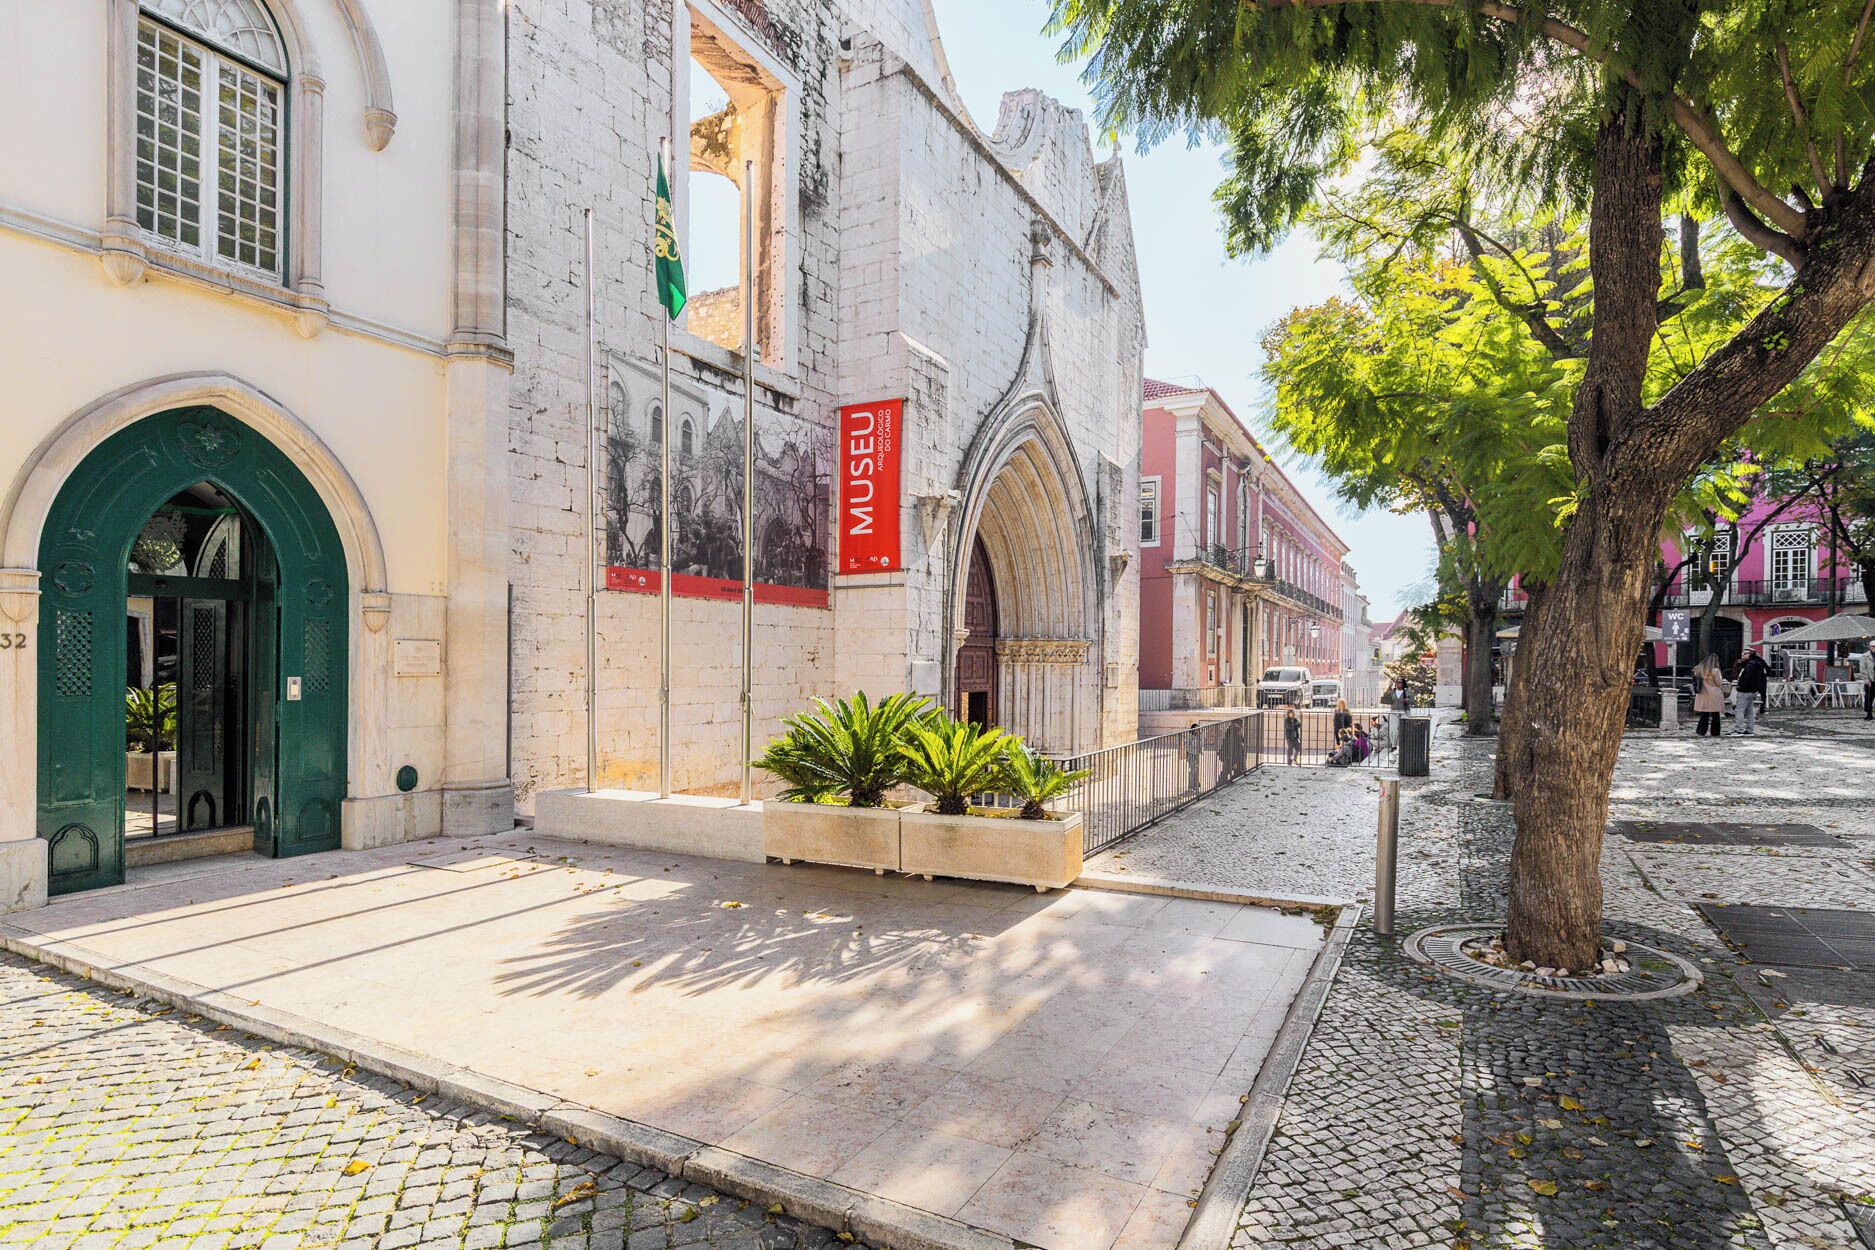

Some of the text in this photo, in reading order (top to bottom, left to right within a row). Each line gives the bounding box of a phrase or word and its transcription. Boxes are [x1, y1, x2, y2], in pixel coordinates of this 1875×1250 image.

[877, 410, 885, 471] ARQUEOLÓGICO
[885, 439, 891, 451] DO
[850, 411, 874, 535] MUSEU
[1667, 612, 1685, 620] WC
[0, 633, 26, 649] 32
